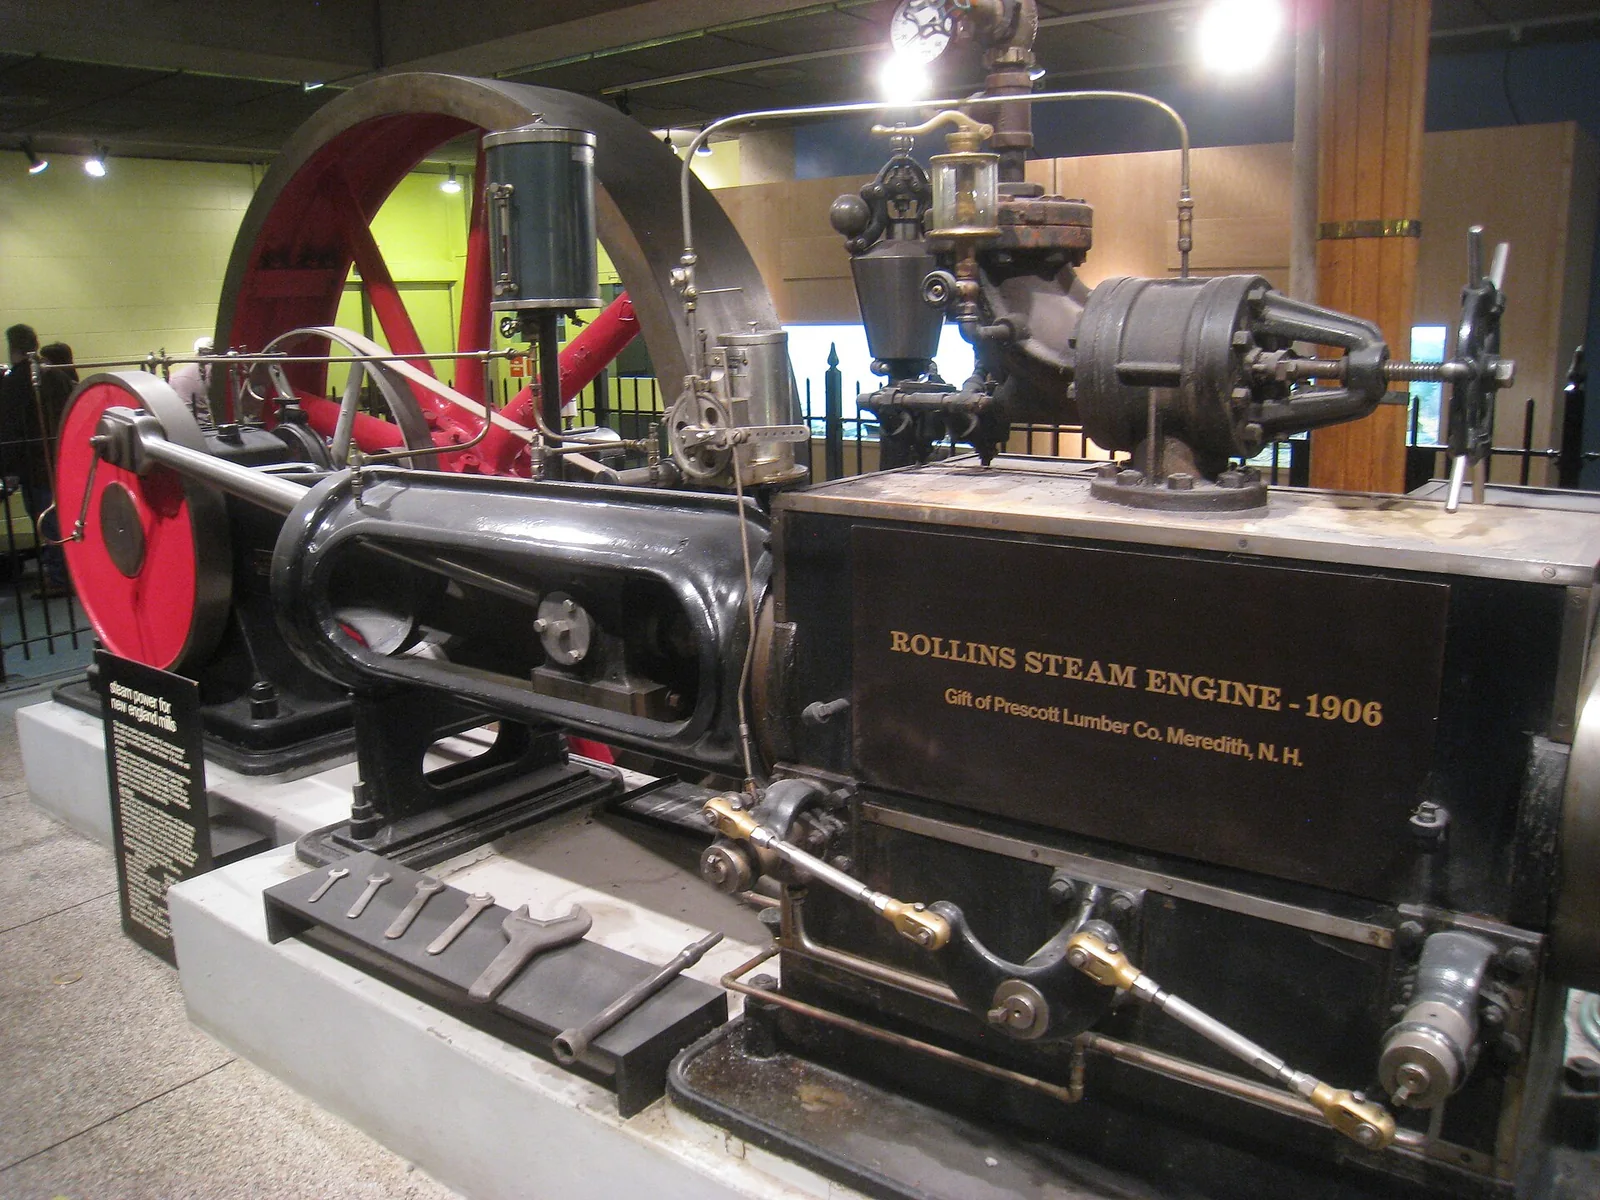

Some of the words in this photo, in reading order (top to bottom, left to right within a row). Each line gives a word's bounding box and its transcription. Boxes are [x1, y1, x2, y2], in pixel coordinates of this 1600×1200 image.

[110, 681, 133, 700] steam
[133, 690, 158, 709] power
[159, 697, 172, 714] for
[890, 630, 1016, 670] ROLLINS
[1024, 650, 1137, 689] STEAM
[1144, 668, 1282, 712] ENGINE
[1305, 693, 1384, 727] 1906
[111, 698, 127, 713] new
[128, 704, 158, 725] england
[159, 715, 177, 732] mills
[944, 688, 973, 707] Gift
[975, 694, 993, 710] of
[994, 696, 1061, 723] Prescott
[1063, 708, 1131, 735] Lumber
[1133, 720, 1163, 742] Co.
[1167, 726, 1254, 761] Meredith,
[1258, 742, 1279, 762] N.
[1282, 747, 1304, 767] H.
